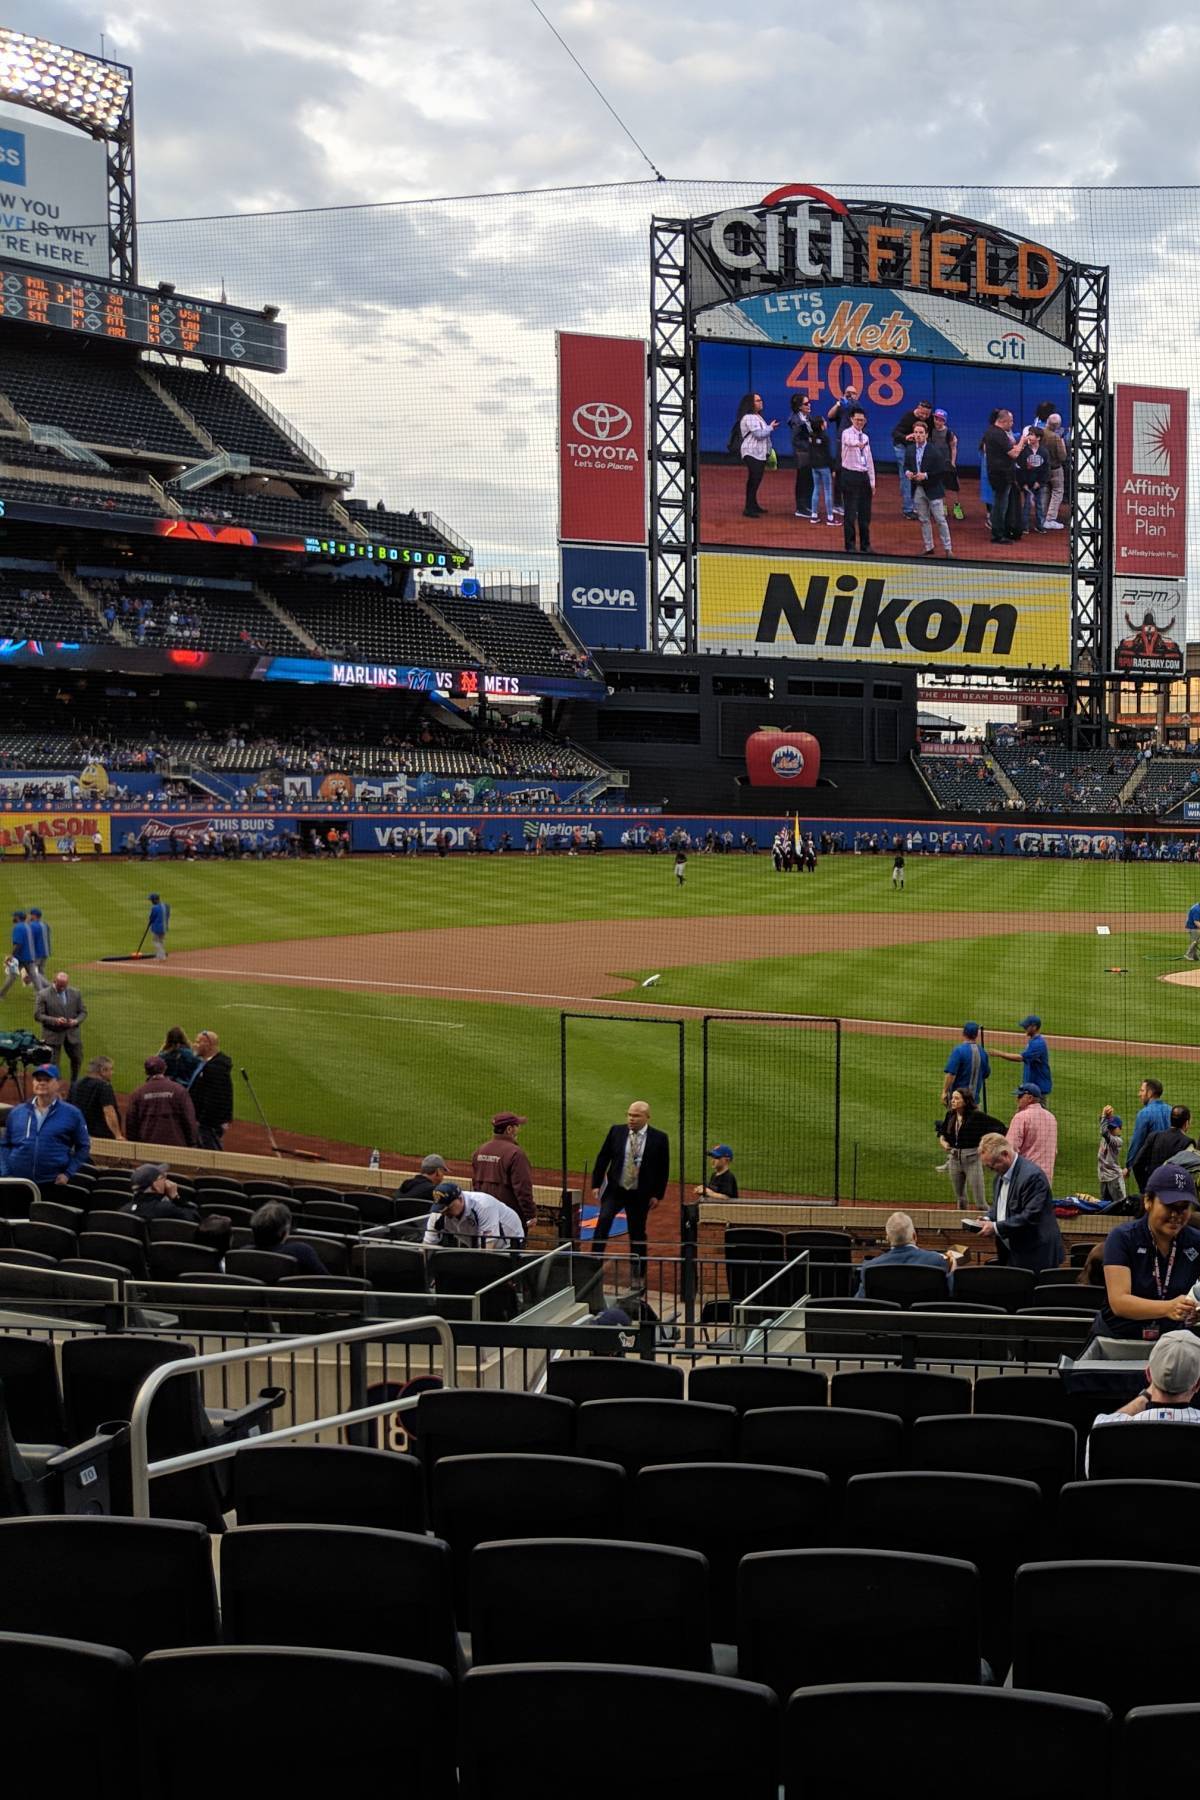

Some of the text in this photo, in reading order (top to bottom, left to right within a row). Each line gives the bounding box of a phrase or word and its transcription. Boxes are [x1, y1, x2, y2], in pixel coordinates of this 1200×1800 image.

[20, 197, 59, 219] YOU
[31, 219, 97, 247] IS WHY
[35, 242, 89, 267] HERE.
[710, 196, 1060, 299] citi FIELD
[73, 279, 148, 300] NATIONAL
[158, 297, 213, 313] LEAGUE
[764, 291, 823, 314] LET'S
[797, 311, 826, 327] GO
[812, 300, 914, 353] Mets
[987, 333, 1026, 360] citi
[786, 352, 905, 406] 408
[567, 443, 639, 462] TOYOTA
[574, 460, 633, 471] Let's Go Places
[1123, 479, 1180, 501] Affinity
[1127, 499, 1175, 518] Health
[1135, 519, 1166, 536] Plan
[571, 586, 635, 606] GOYA
[1122, 589, 1168, 602] RPM
[755, 572, 1018, 656] Nikon
[332, 664, 519, 694] MARLINS VS METS
[920, 691, 938, 699] THE
[963, 692, 989, 701] BEAM
[993, 693, 1037, 703] BOURBON
[1041, 695, 1059, 703] BAR
[214, 818, 275, 831] THIS BUD'S
[82, 1469, 95, 1483] 10
